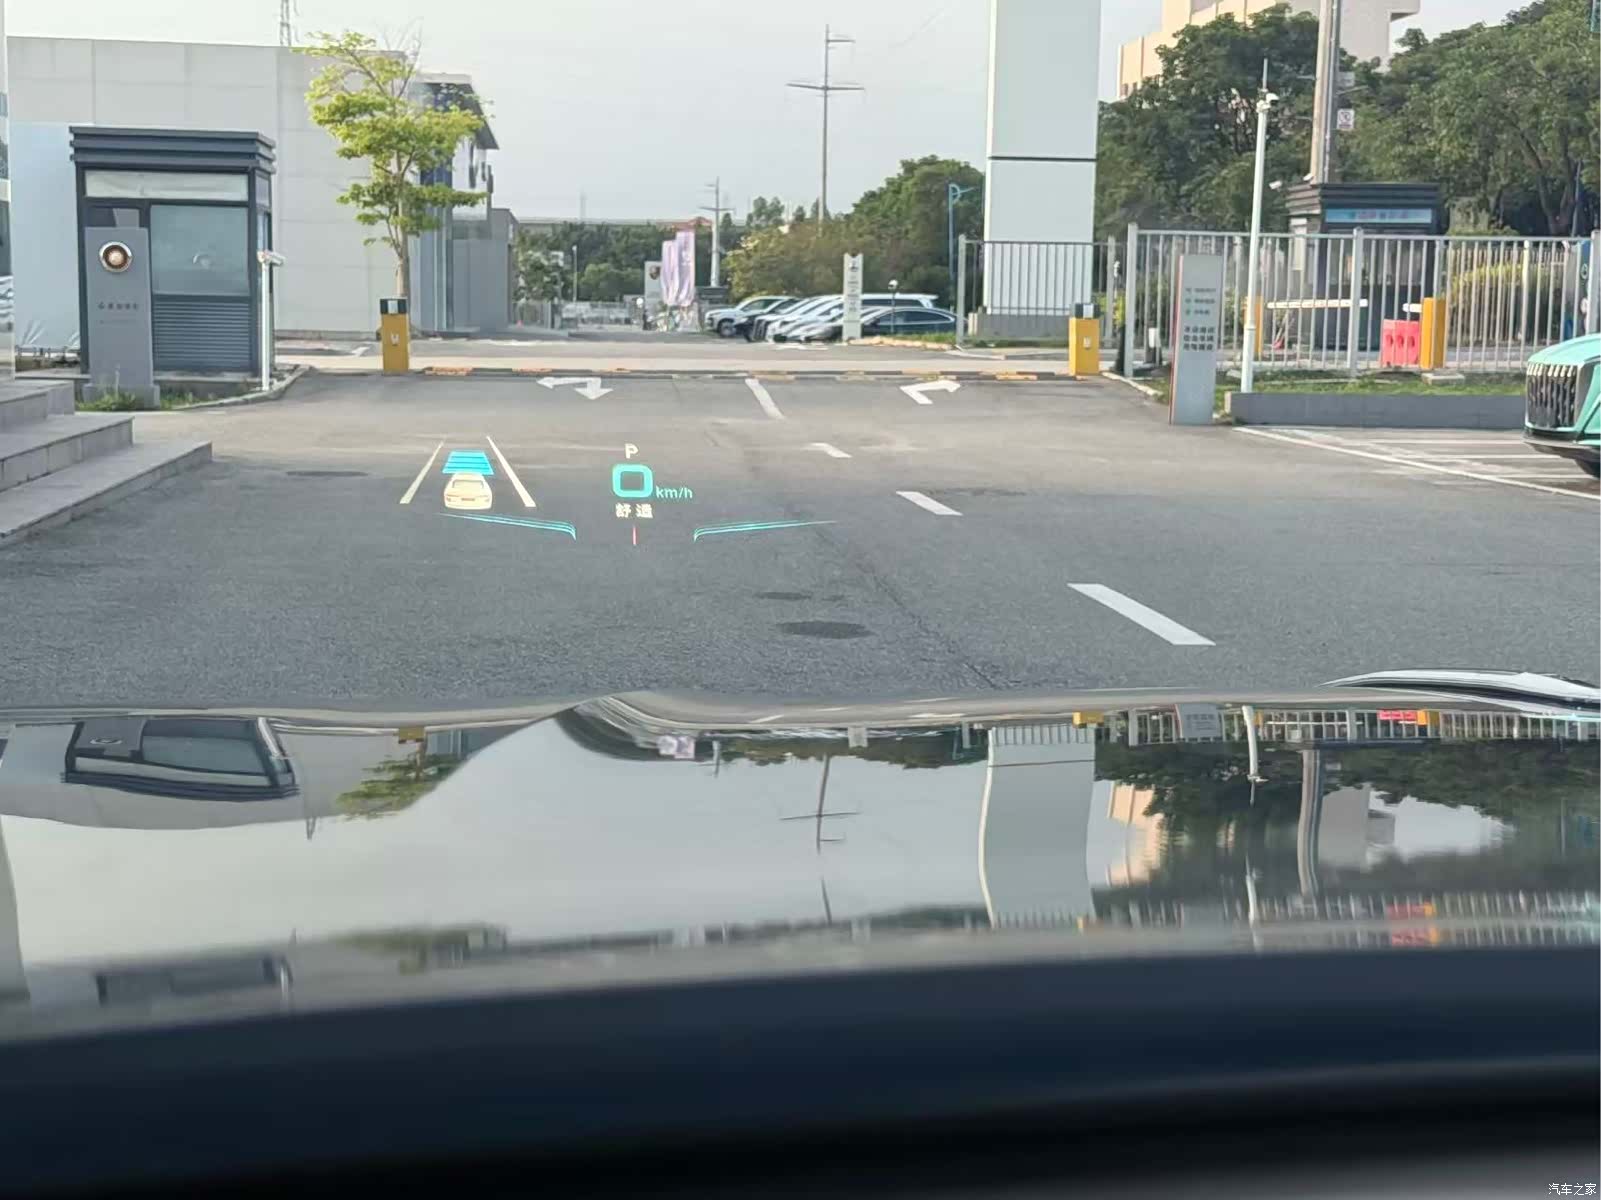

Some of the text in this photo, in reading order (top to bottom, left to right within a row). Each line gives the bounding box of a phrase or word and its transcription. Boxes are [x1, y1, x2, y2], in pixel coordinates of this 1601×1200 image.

[624, 443, 639, 459] P
[612, 463, 693, 499] 0 km/h
[615, 503, 653, 519] 舒适
